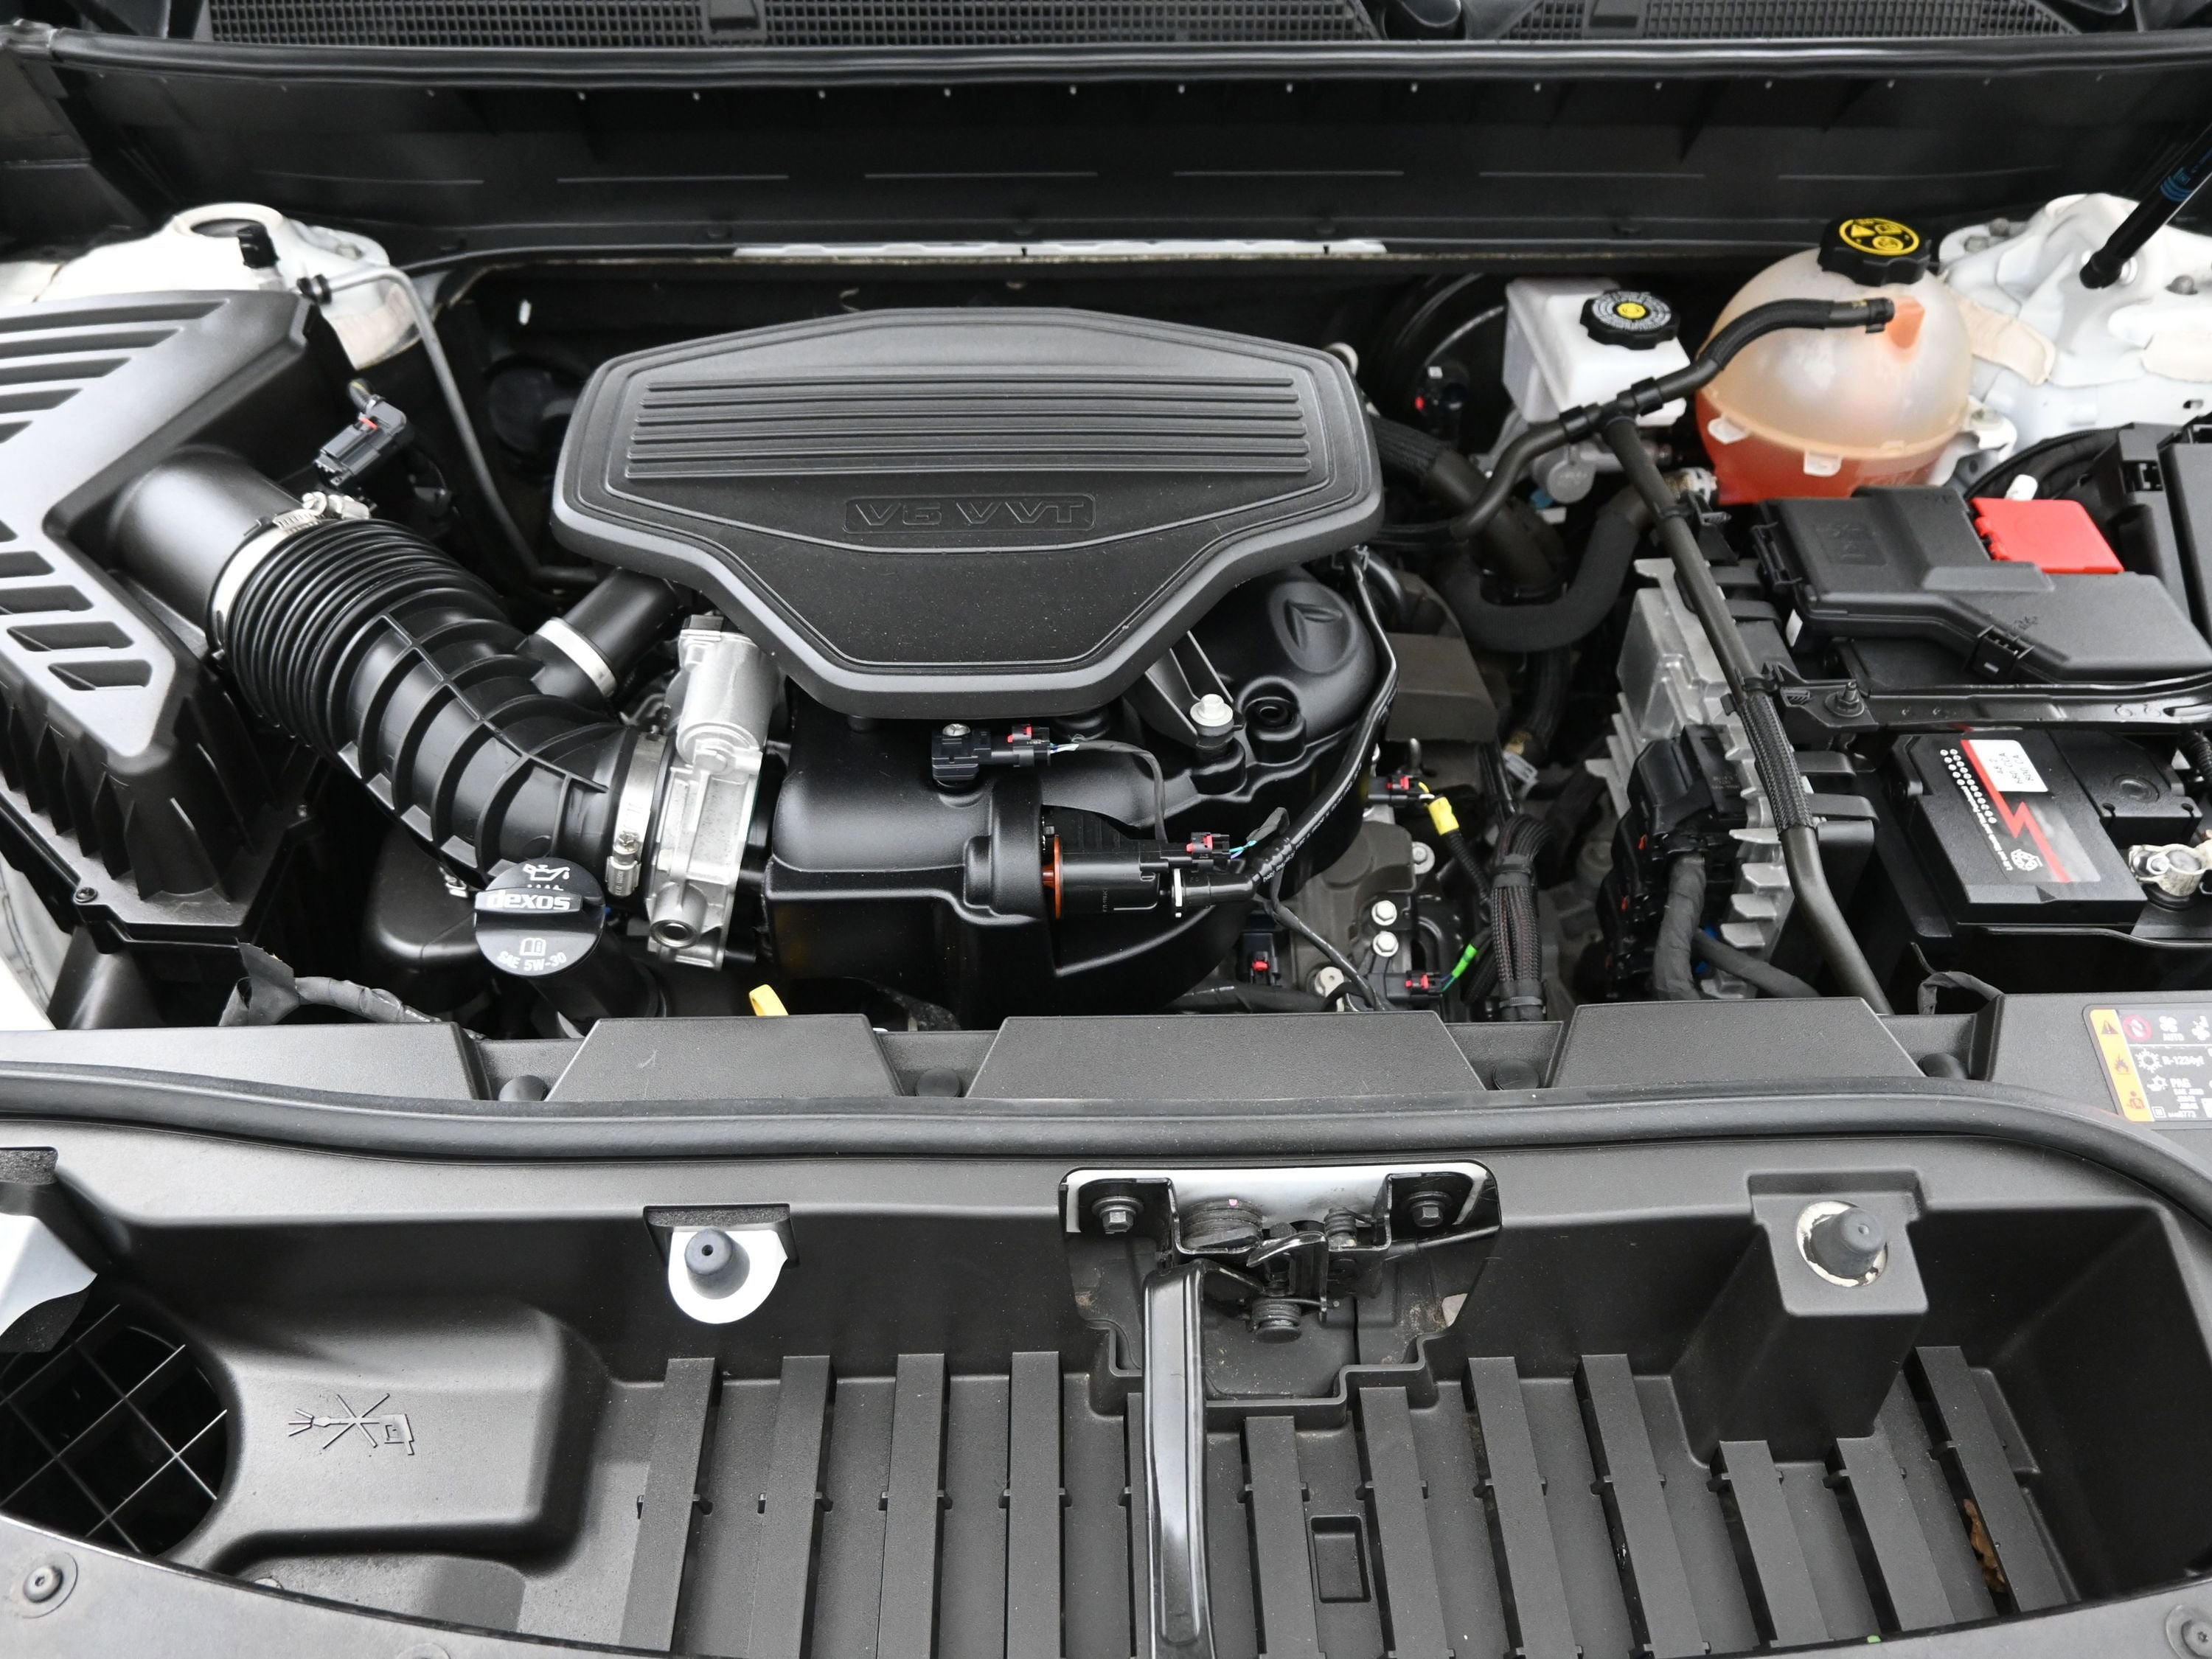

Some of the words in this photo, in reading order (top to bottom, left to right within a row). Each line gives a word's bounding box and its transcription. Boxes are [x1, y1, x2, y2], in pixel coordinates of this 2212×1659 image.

[855, 501, 942, 526] V6
[956, 500, 1085, 525] VVT
[485, 889, 571, 911] dexos
[497, 951, 521, 969] SAE
[524, 952, 567, 972] 5W-30
